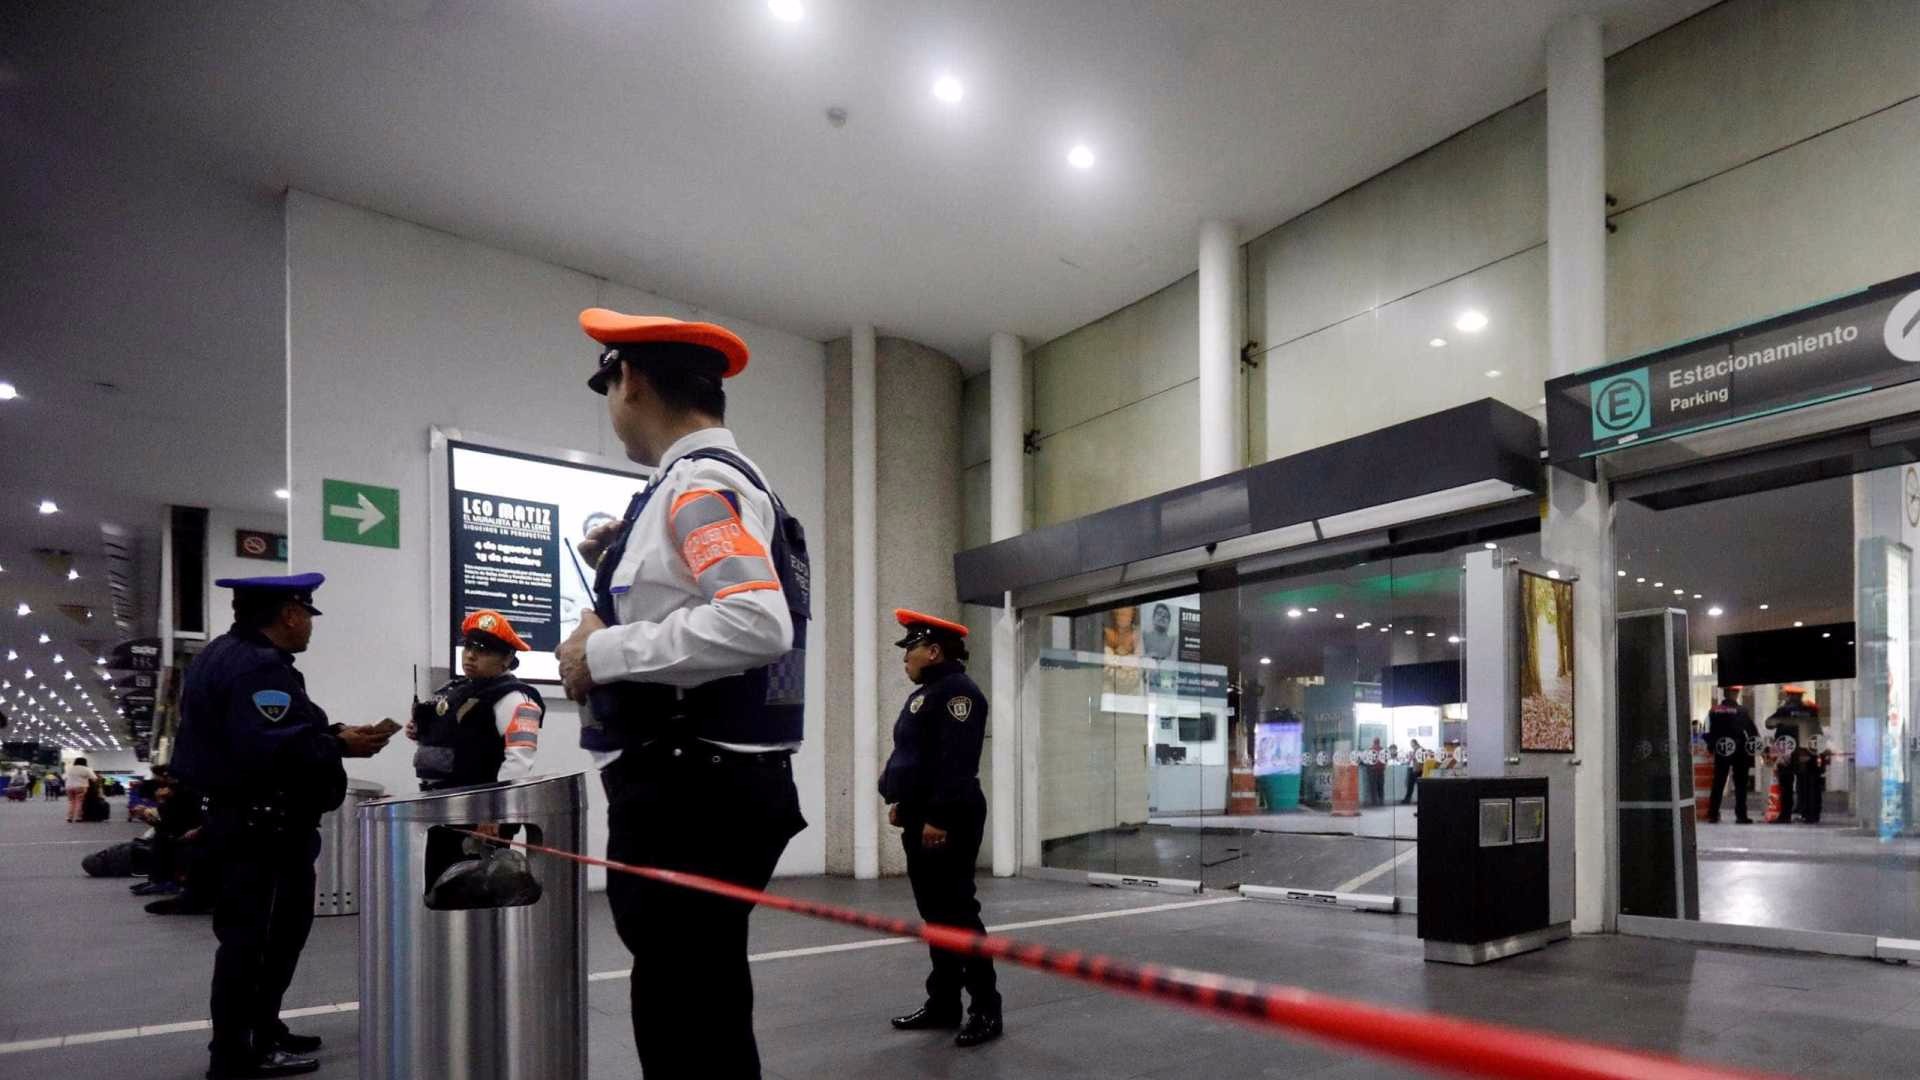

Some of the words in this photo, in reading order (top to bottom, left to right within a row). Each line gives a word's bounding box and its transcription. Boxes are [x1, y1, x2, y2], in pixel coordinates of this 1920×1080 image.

[1669, 325, 1859, 389] Estacionamiento
[1608, 386, 1634, 422] E
[1670, 386, 1730, 412] Parking
[472, 515, 511, 527] MURALISTA
[522, 521, 531, 529] LA
[498, 502, 551, 525] MATIZ
